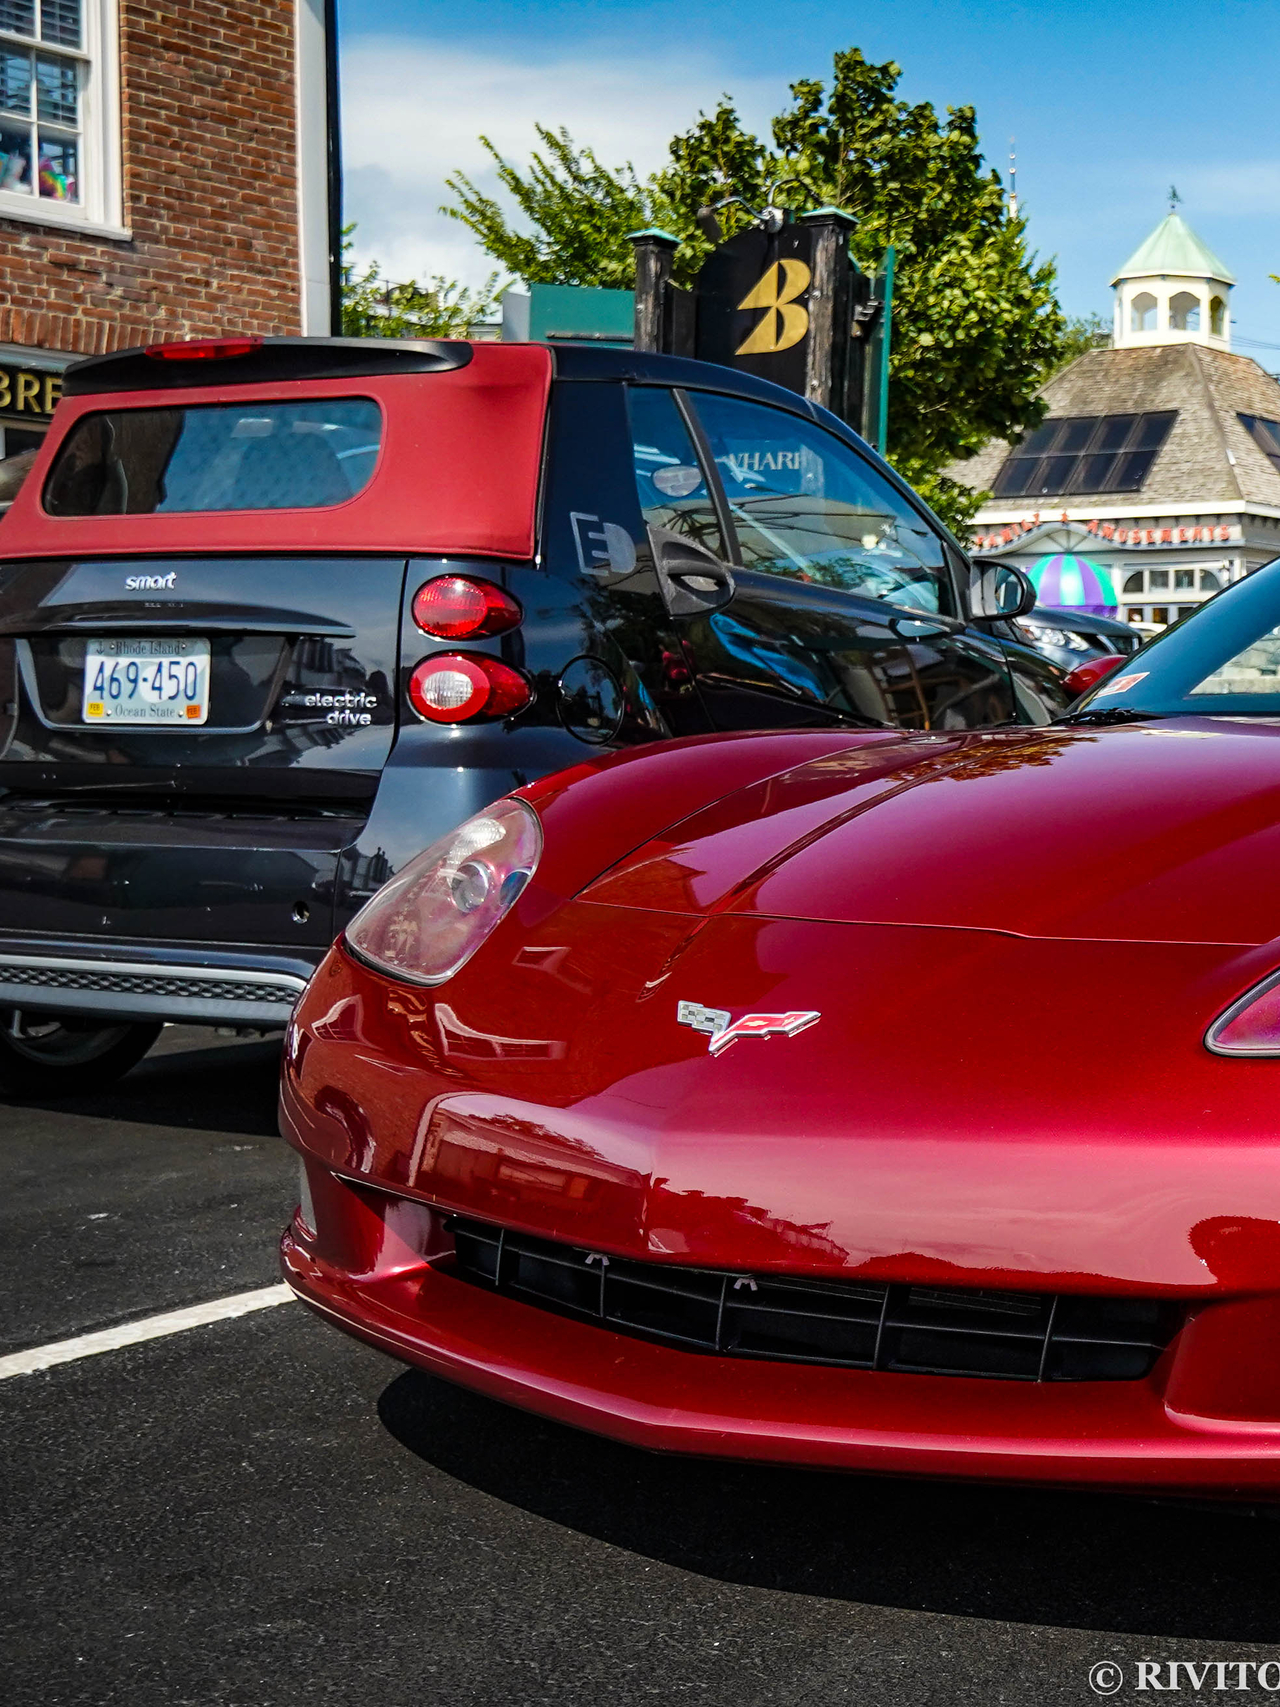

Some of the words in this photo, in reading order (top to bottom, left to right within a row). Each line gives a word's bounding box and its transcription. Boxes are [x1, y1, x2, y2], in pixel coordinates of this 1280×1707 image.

[1087, 519, 1230, 544] AMUSEMENTS
[125, 572, 177, 591] smart
[115, 641, 147, 655] Rhode
[150, 641, 180, 655] Island
[93, 660, 198, 701] 469-450
[304, 692, 378, 708] electric
[115, 703, 147, 718] Ocean
[149, 704, 176, 718] State
[326, 709, 372, 725] drive
